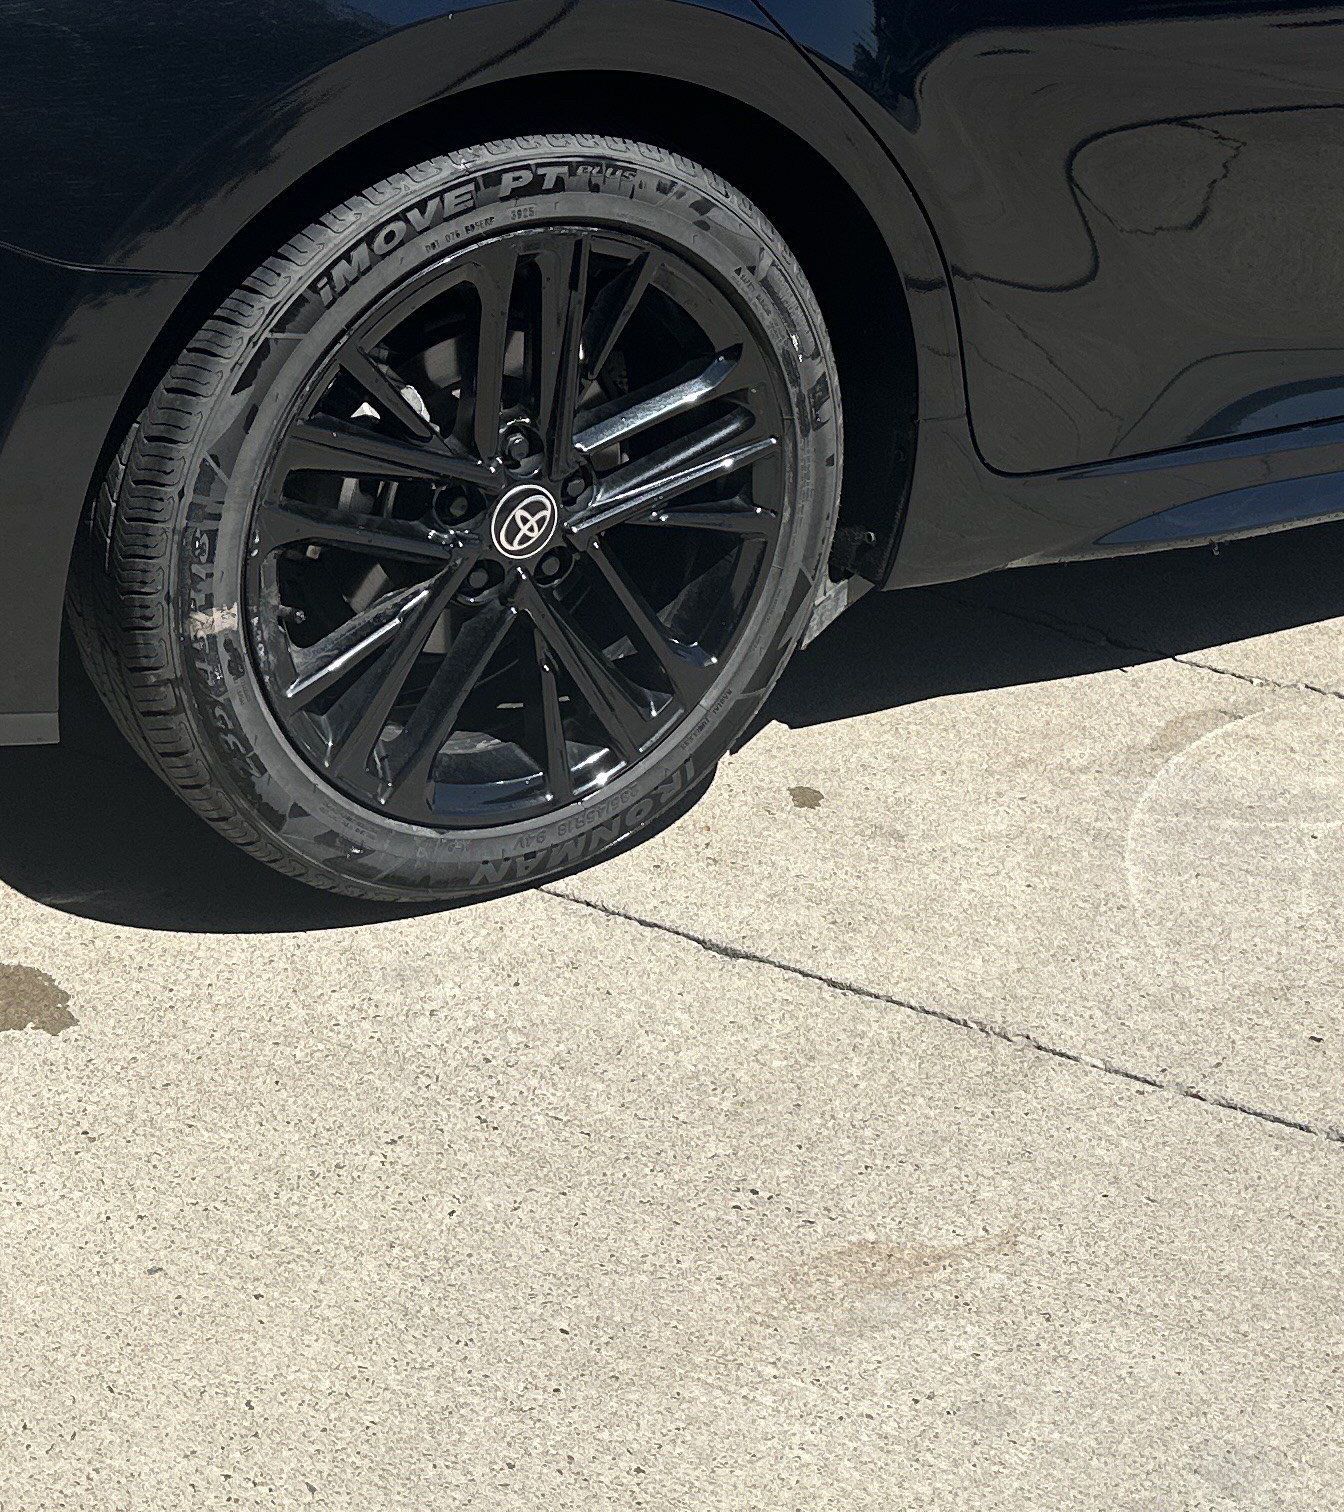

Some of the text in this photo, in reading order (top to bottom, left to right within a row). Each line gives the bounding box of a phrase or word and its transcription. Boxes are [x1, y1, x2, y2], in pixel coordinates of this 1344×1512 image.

[317, 189, 476, 307] iMOVE
[498, 165, 569, 198] PT
[468, 755, 696, 888] IRONMAN
